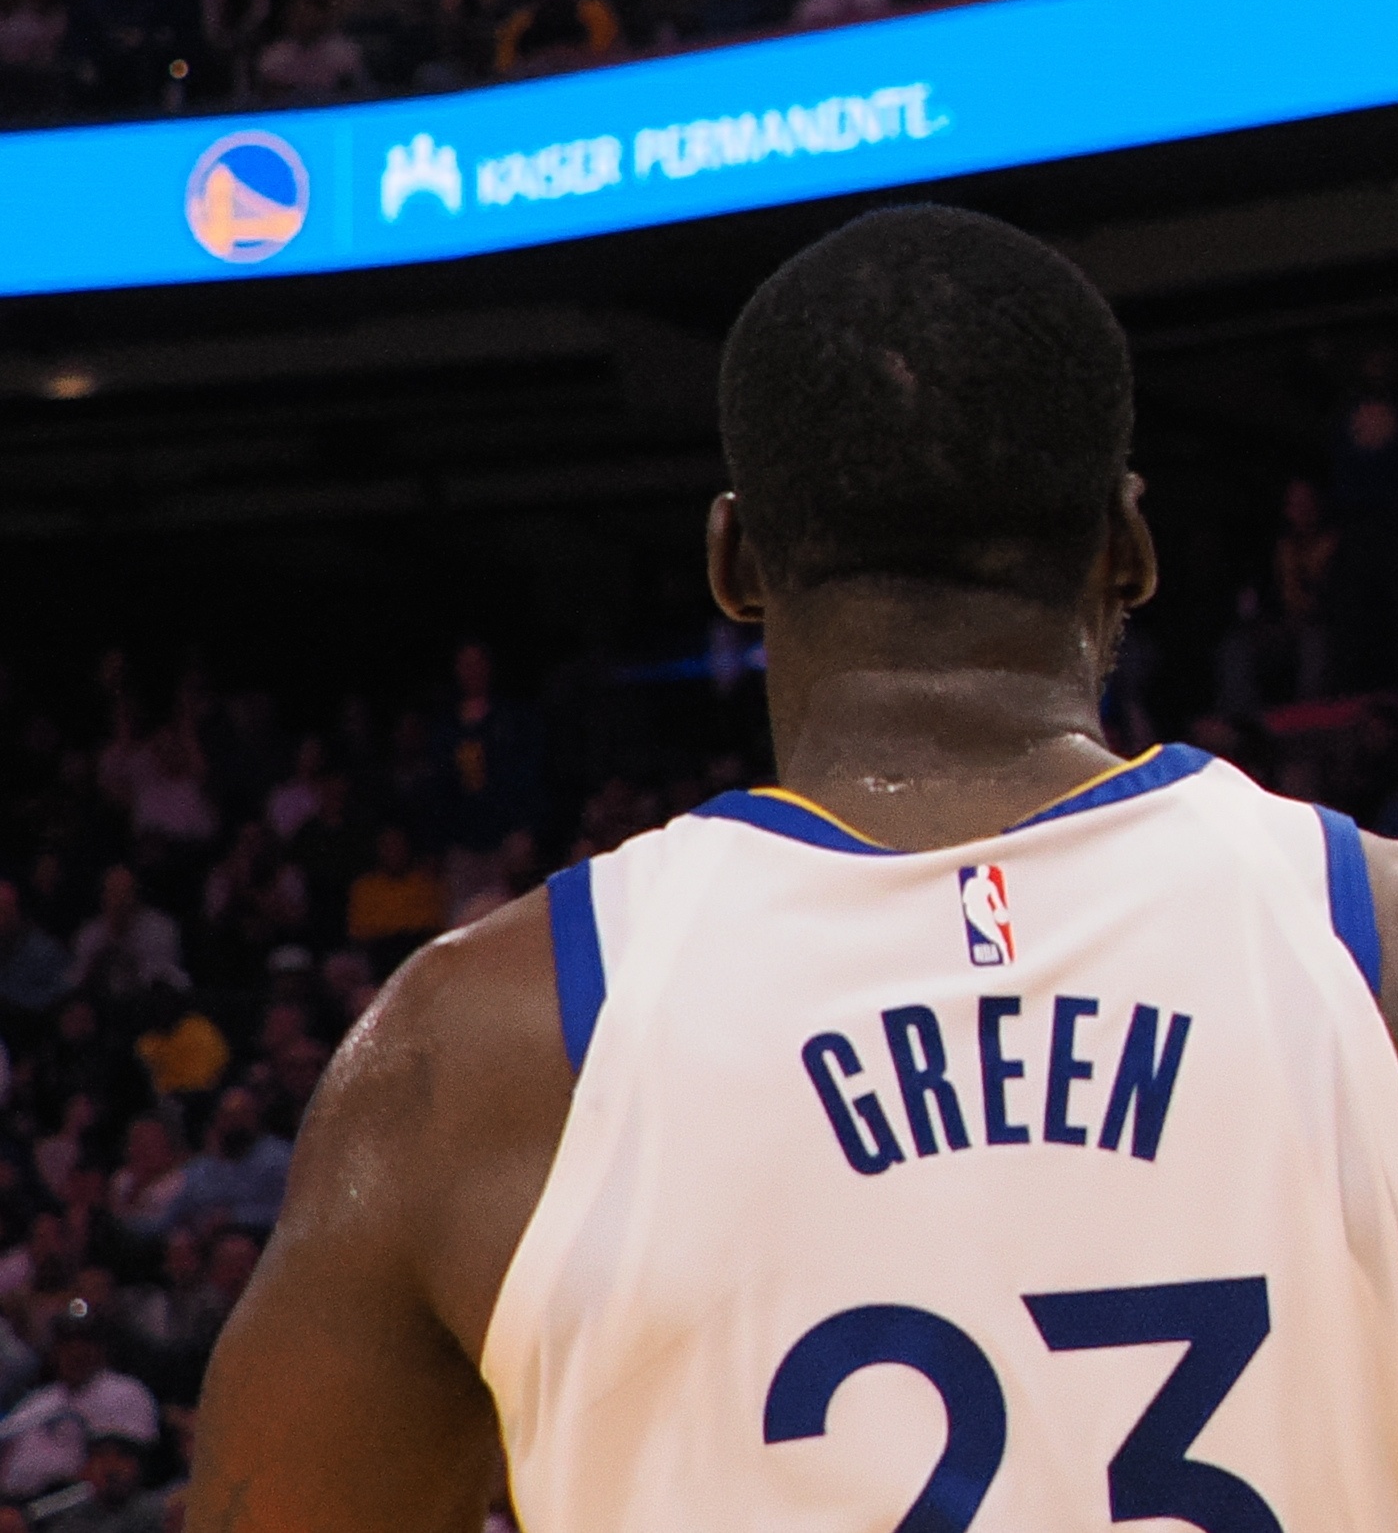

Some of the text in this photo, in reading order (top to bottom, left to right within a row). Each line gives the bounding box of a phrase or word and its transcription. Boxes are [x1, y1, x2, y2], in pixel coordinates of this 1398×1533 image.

[477, 135, 622, 207] KAISER
[802, 995, 1192, 1177] GREEN
[763, 1275, 1285, 1533] 23
